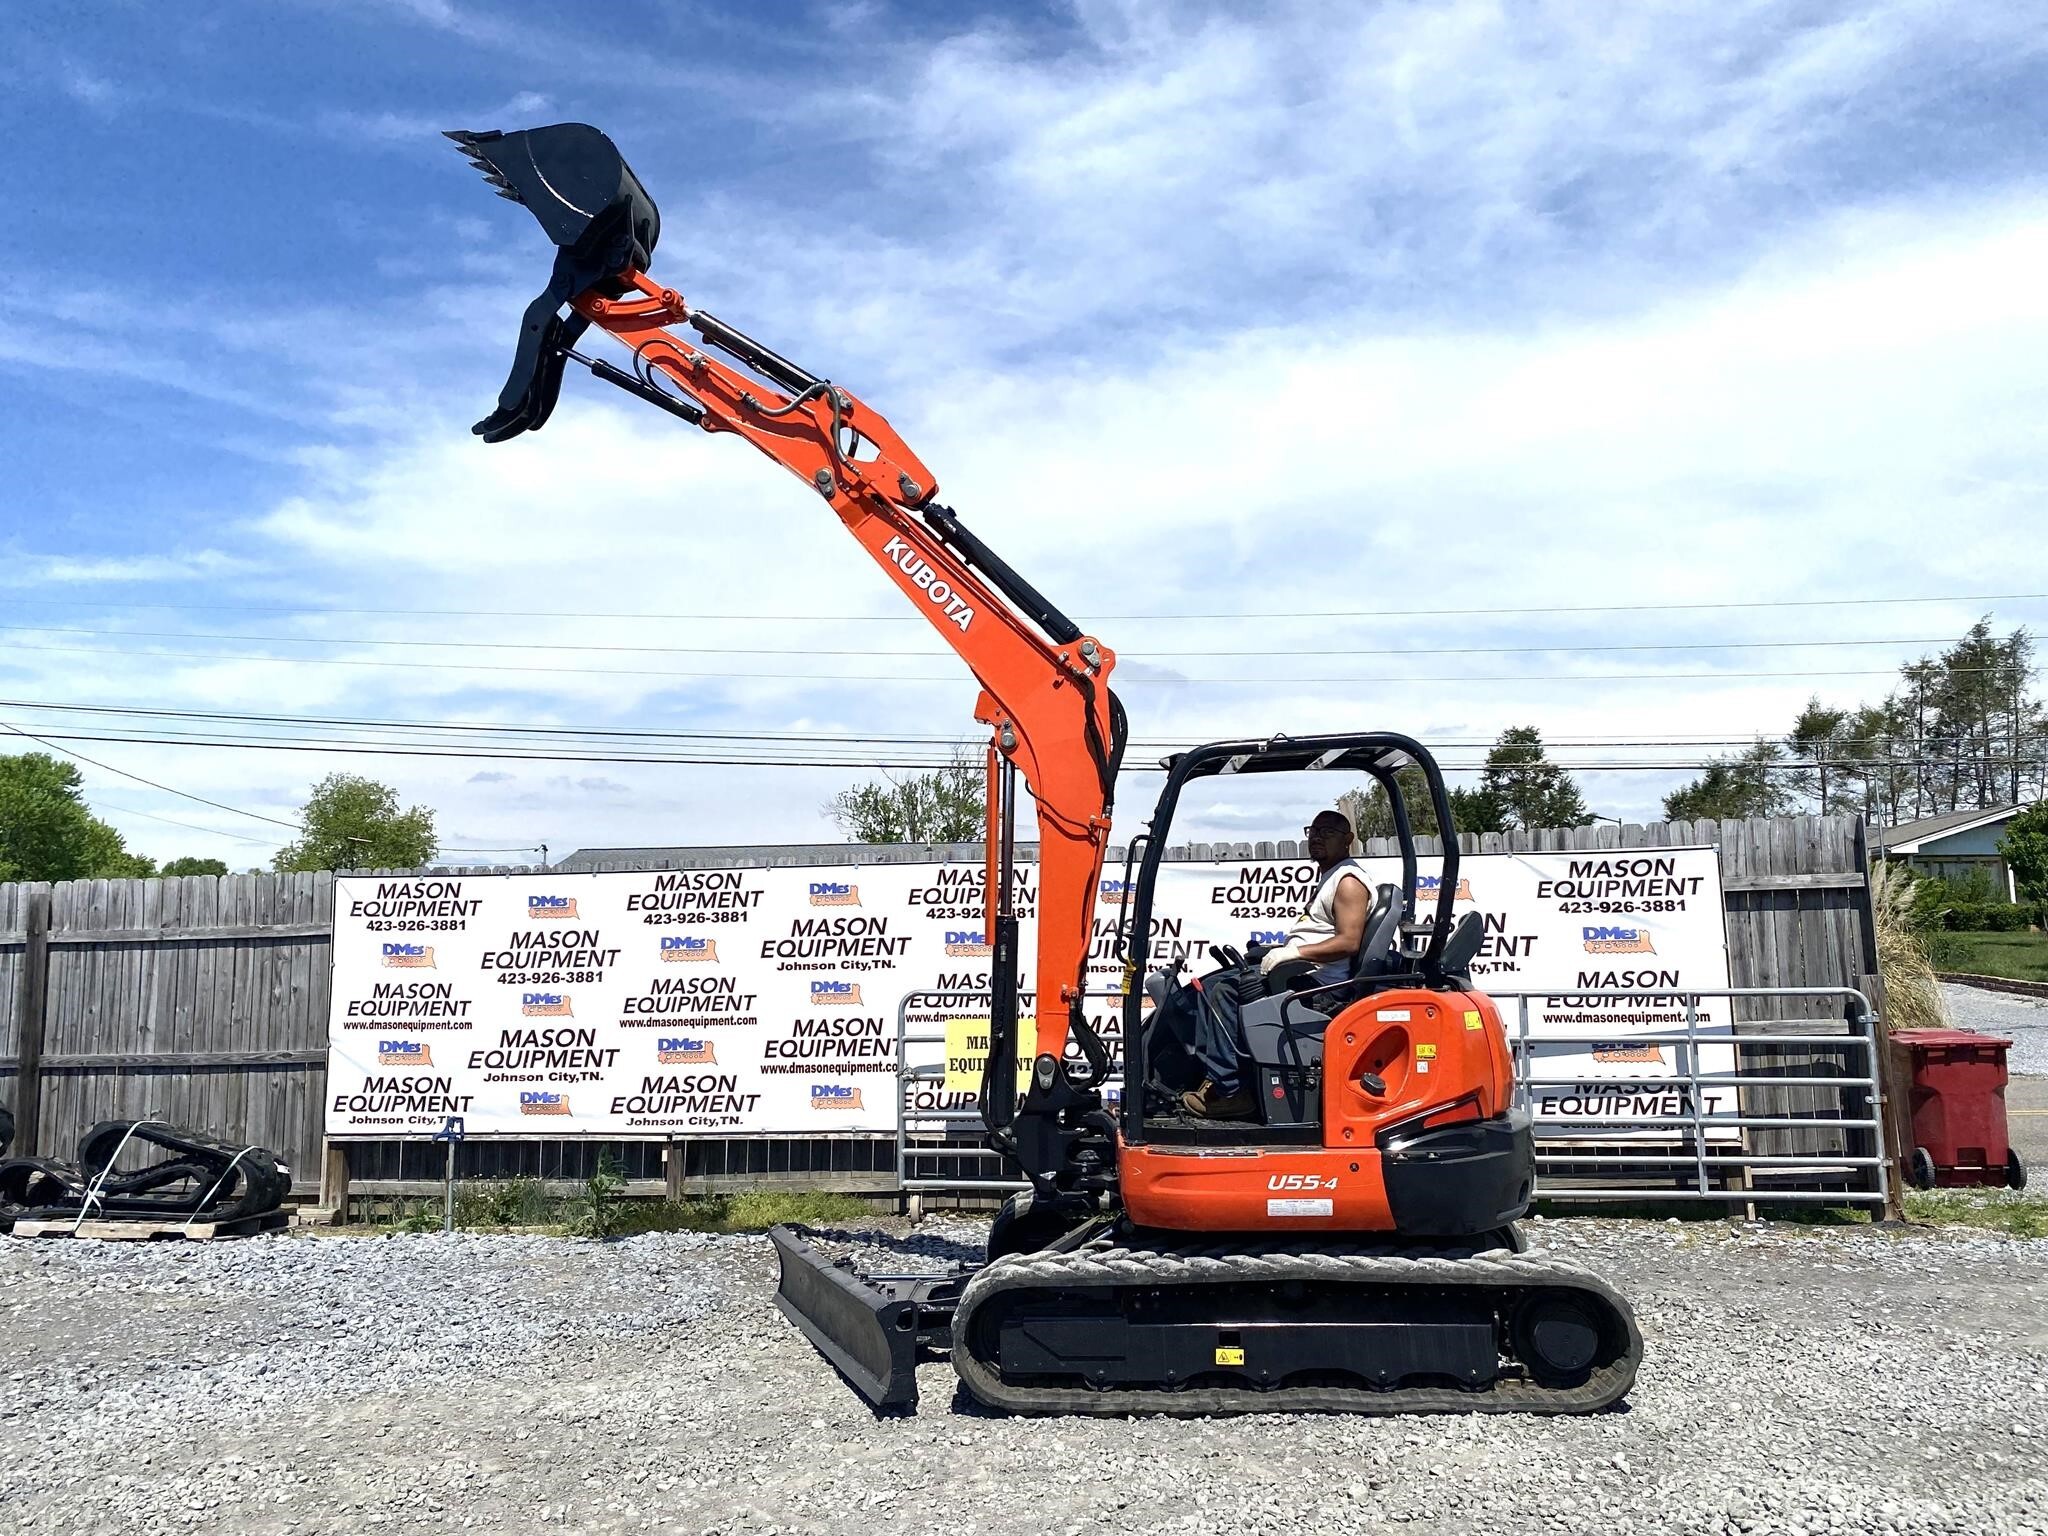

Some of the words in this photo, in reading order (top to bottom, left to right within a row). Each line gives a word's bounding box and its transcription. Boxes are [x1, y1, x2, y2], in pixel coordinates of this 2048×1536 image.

[883, 535, 975, 632] KUBOTA
[1240, 866, 1320, 885] MASO
[1569, 858, 1675, 878] MASON
[654, 872, 743, 892] MASON
[936, 869, 1029, 886] MASN
[1100, 880, 1137, 892] DMe
[377, 882, 462, 899] MASON
[1211, 886, 1318, 904] EQUIPM
[1537, 877, 1704, 899] EQUIPMENT
[350, 900, 483, 917] EQUIPMENT
[627, 890, 764, 911] EQUIPMENT
[1559, 899, 1686, 914] 423-926-3881
[366, 920, 465, 931] 423-926-3881
[643, 911, 747, 925] 423-926-3881
[791, 917, 888, 937] MASON
[510, 930, 599, 949] MASON
[945, 931, 986, 944] DMe
[760, 937, 912, 959] EQUIPMENT
[481, 949, 621, 969] EQUIPMENT
[777, 962, 836, 971] Johnson
[841, 960, 896, 971] City,TN.
[497, 971, 603, 984] 423-926-3881
[650, 977, 736, 995] MASON
[937, 973, 1026, 990] MASN
[1577, 970, 1679, 989] MASON
[373, 983, 452, 999] MASON
[347, 1000, 472, 1016] EQUIPMENT
[623, 994, 757, 1014] EQUIPMENT
[343, 1019, 472, 1032] www.dmasonequipment.com
[619, 1015, 757, 1029] www.dmasonequipment.com
[792, 1018, 884, 1037] MASON
[500, 1028, 596, 1048] MASON
[467, 1049, 620, 1069] EQUIPMENT
[950, 1058, 1033, 1073] EQUINT
[483, 1073, 543, 1082] Johnson
[548, 1071, 604, 1083] City,TN.
[760, 1061, 898, 1076] www.dmasonequipment.co
[362, 1076, 452, 1094] MASON
[641, 1075, 737, 1094] MASON
[333, 1095, 474, 1112] EQUIPMENT
[610, 1094, 761, 1114] EQUIPMENT
[1540, 1097, 1722, 1116] EQUIPMENT
[348, 1115, 404, 1124] Johnson
[626, 1117, 683, 1126] Johnson
[688, 1116, 743, 1127] City,TN.
[1267, 1174, 1339, 1191] U55-4
